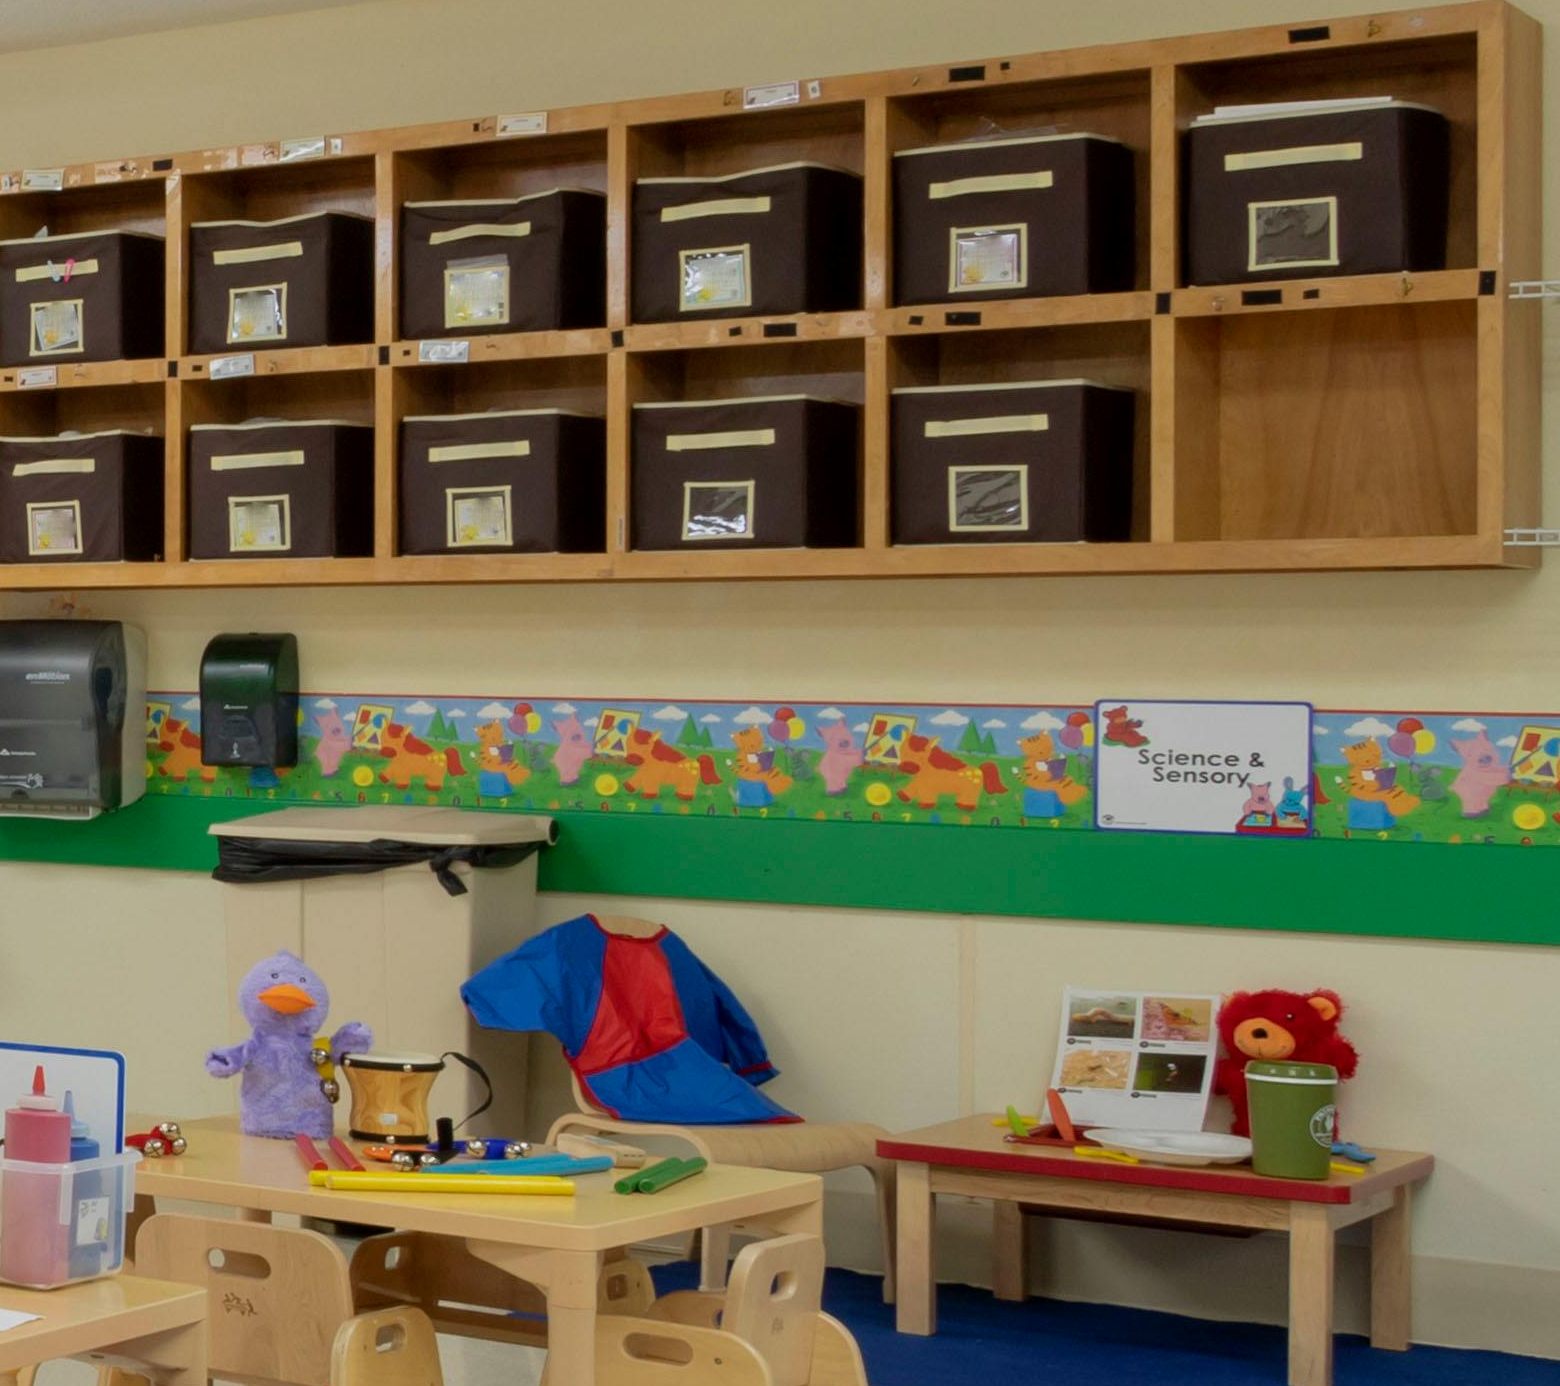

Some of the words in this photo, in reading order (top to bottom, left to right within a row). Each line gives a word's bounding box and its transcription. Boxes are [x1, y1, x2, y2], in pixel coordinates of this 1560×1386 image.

[1138, 749, 1240, 768] Science
[1248, 751, 1266, 769] &
[1152, 766, 1249, 790] Sensory
